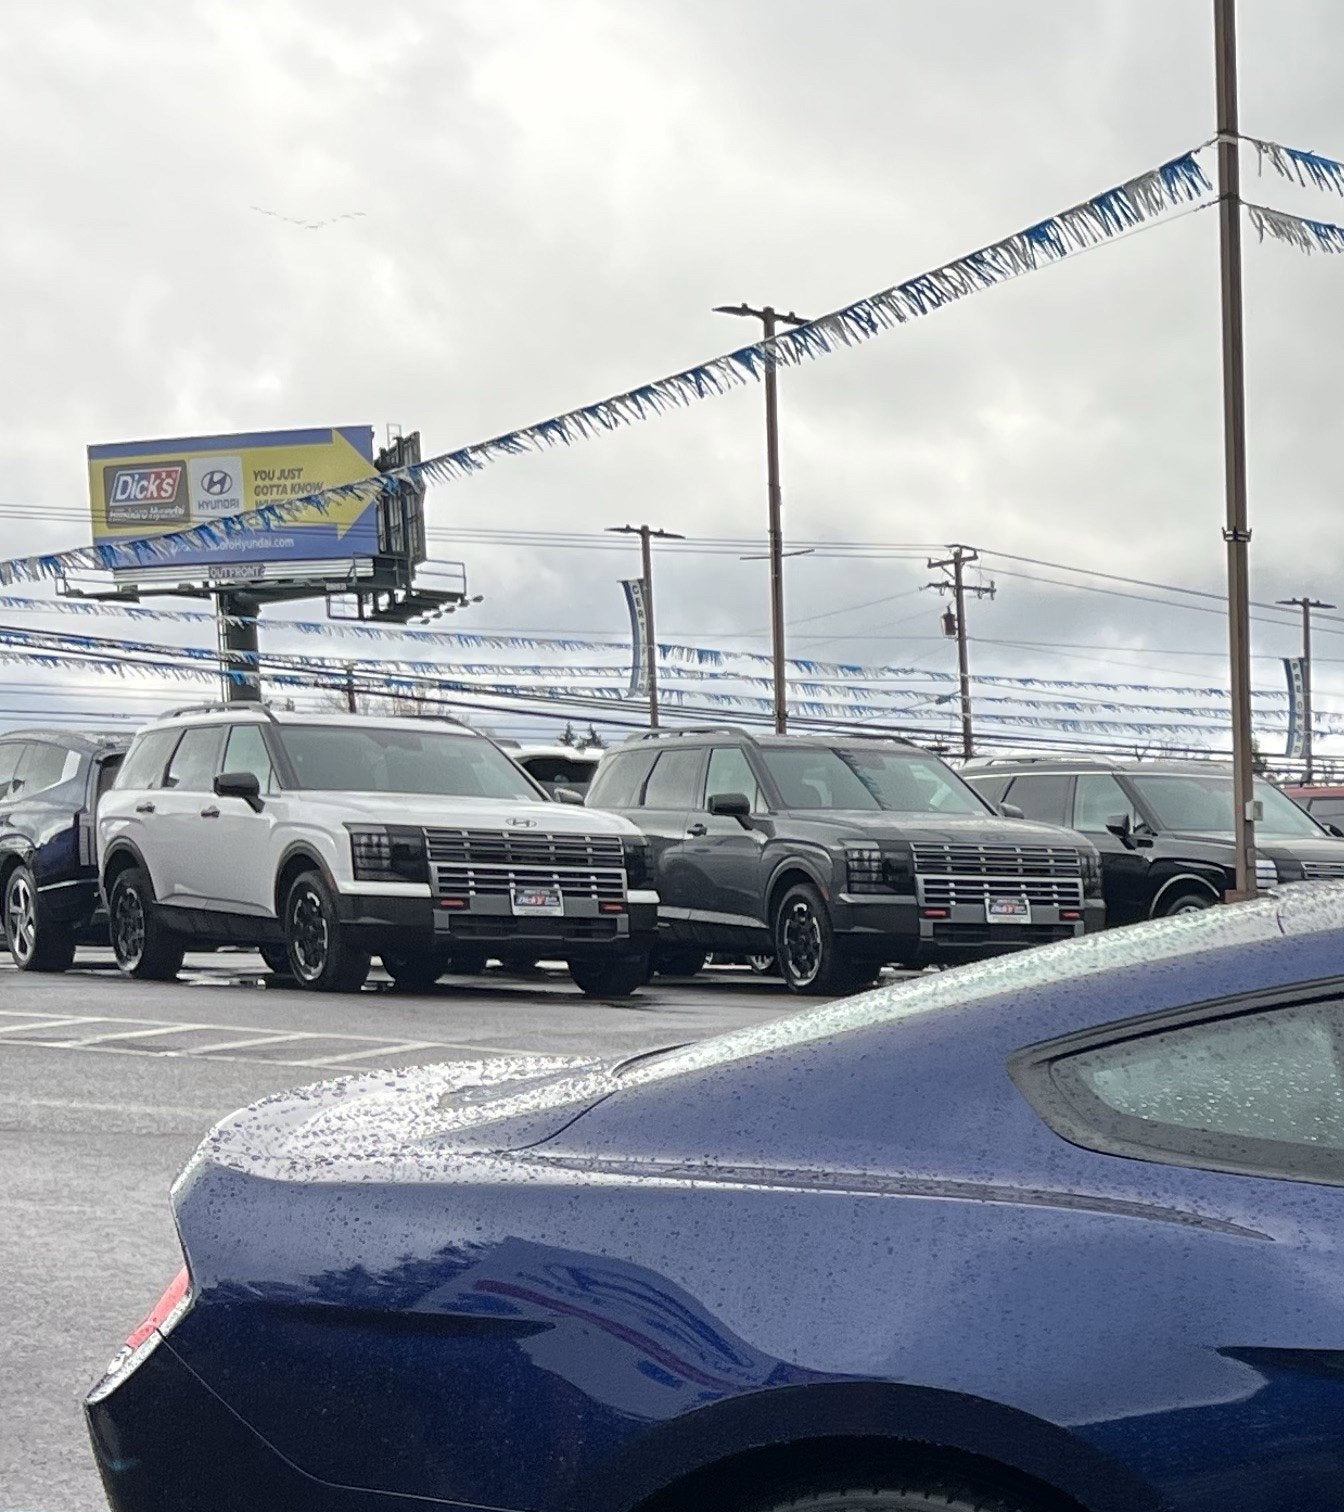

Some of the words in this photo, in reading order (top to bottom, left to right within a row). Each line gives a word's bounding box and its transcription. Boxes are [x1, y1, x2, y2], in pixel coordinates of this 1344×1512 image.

[252, 470, 275, 482] YOU
[277, 467, 303, 480] JUST
[115, 472, 175, 500] Dick's
[254, 484, 289, 497] GOTTA
[290, 481, 323, 496] KNOW
[198, 497, 240, 510] HYUNDAI
